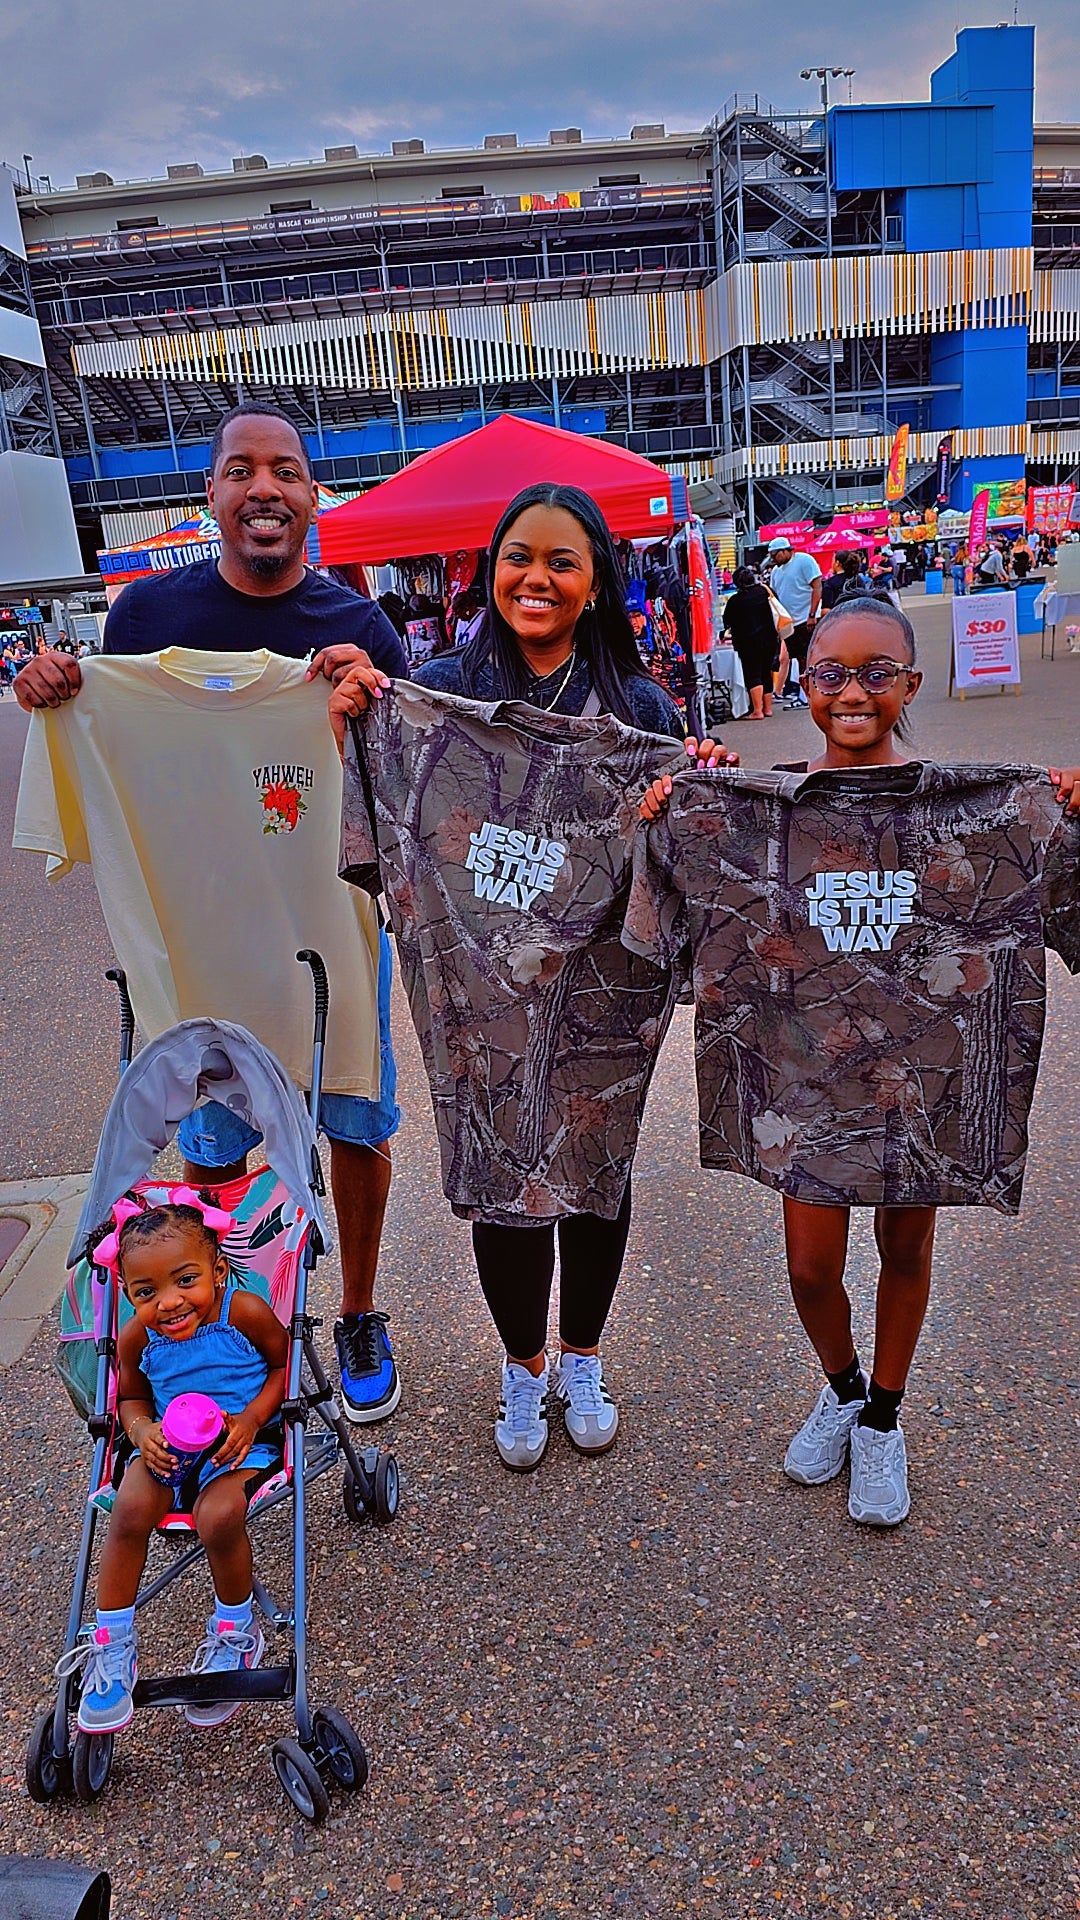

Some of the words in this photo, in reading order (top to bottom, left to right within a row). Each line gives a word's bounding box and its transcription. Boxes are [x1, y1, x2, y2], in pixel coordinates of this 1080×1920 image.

[972, 503, 986, 543] Mobile
[966, 619, 1006, 637] $30
[252, 764, 314, 788] YAHWEH
[469, 821, 567, 868] JESUS
[464, 844, 497, 874] IS
[498, 852, 559, 893] THE
[474, 871, 542, 912] WAY
[804, 870, 917, 900] JESUS
[808, 899, 842, 927] IS
[843, 897, 914, 926] THE
[821, 924, 900, 952] WAY
